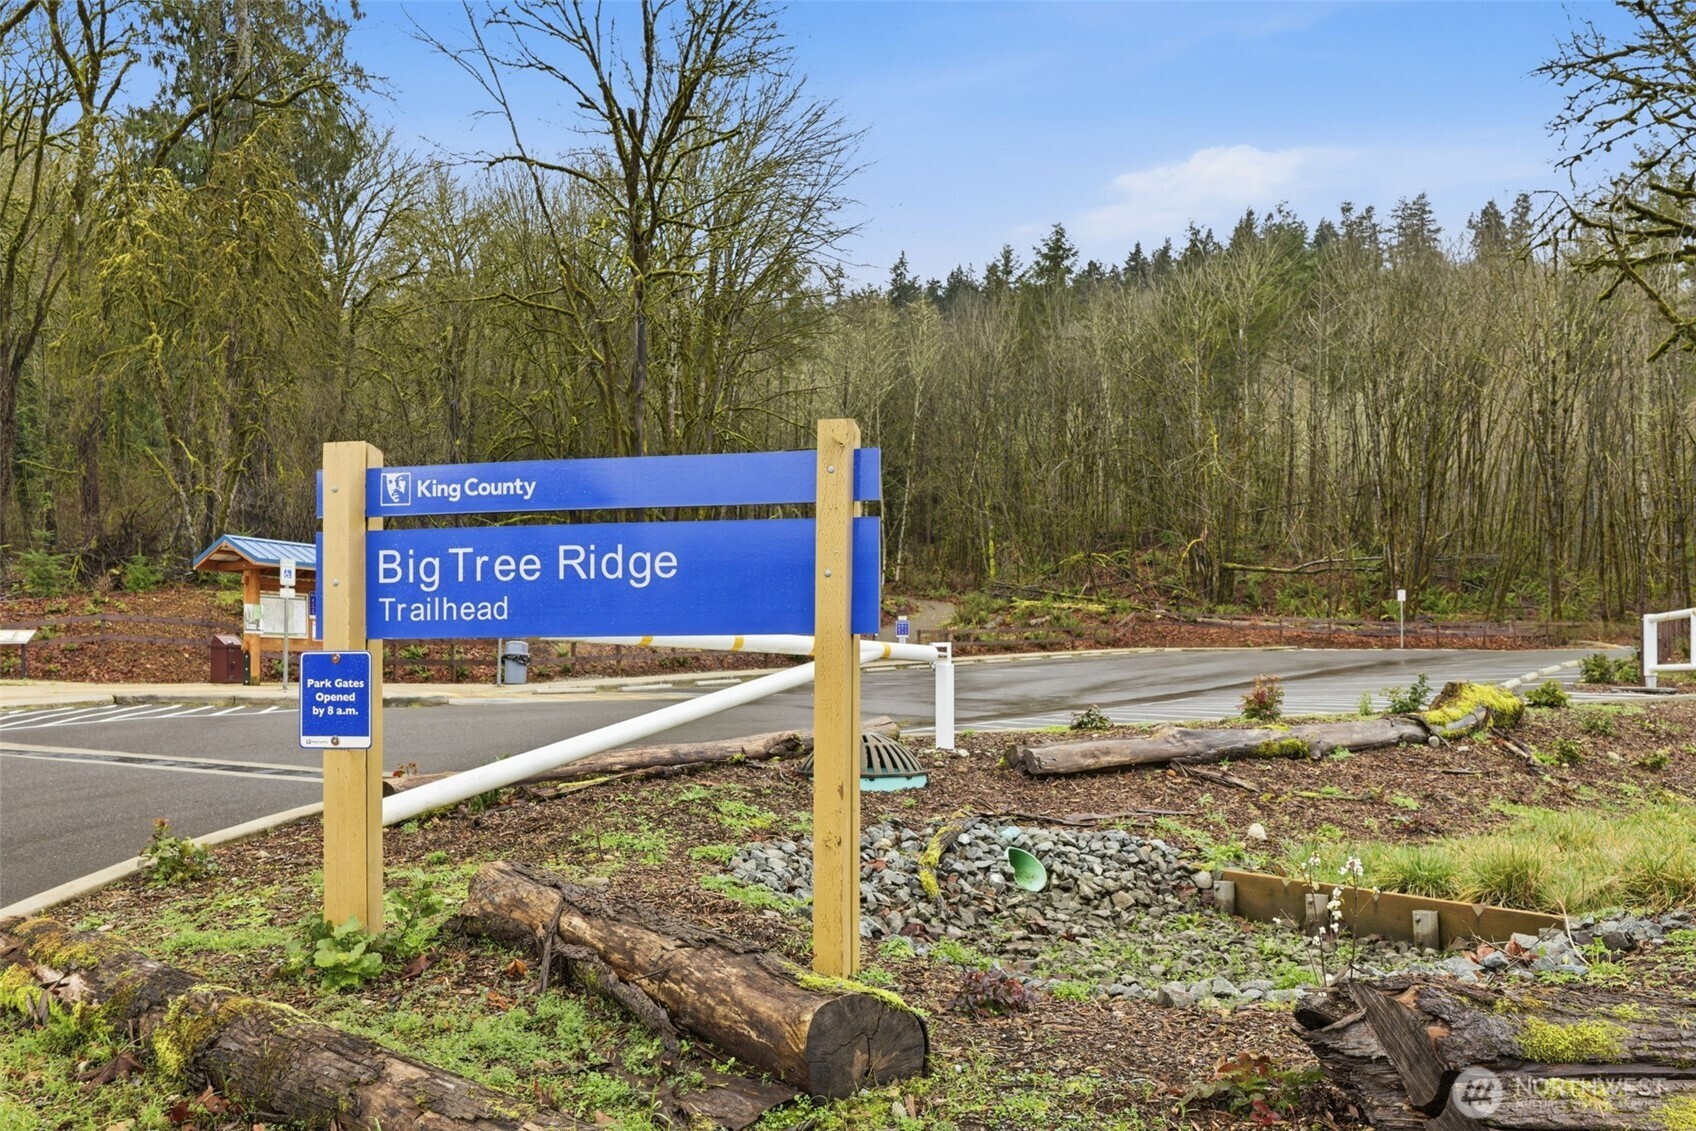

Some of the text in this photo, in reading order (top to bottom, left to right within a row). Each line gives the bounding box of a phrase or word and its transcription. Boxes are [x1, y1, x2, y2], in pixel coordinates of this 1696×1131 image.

[416, 478, 537, 502] King County
[378, 544, 679, 592] Big Tree Ridge
[378, 596, 508, 622] Trailhead
[306, 678, 365, 688] Park Gates
[315, 692, 356, 704] Opened
[312, 706, 359, 718] by 8 a.m.
